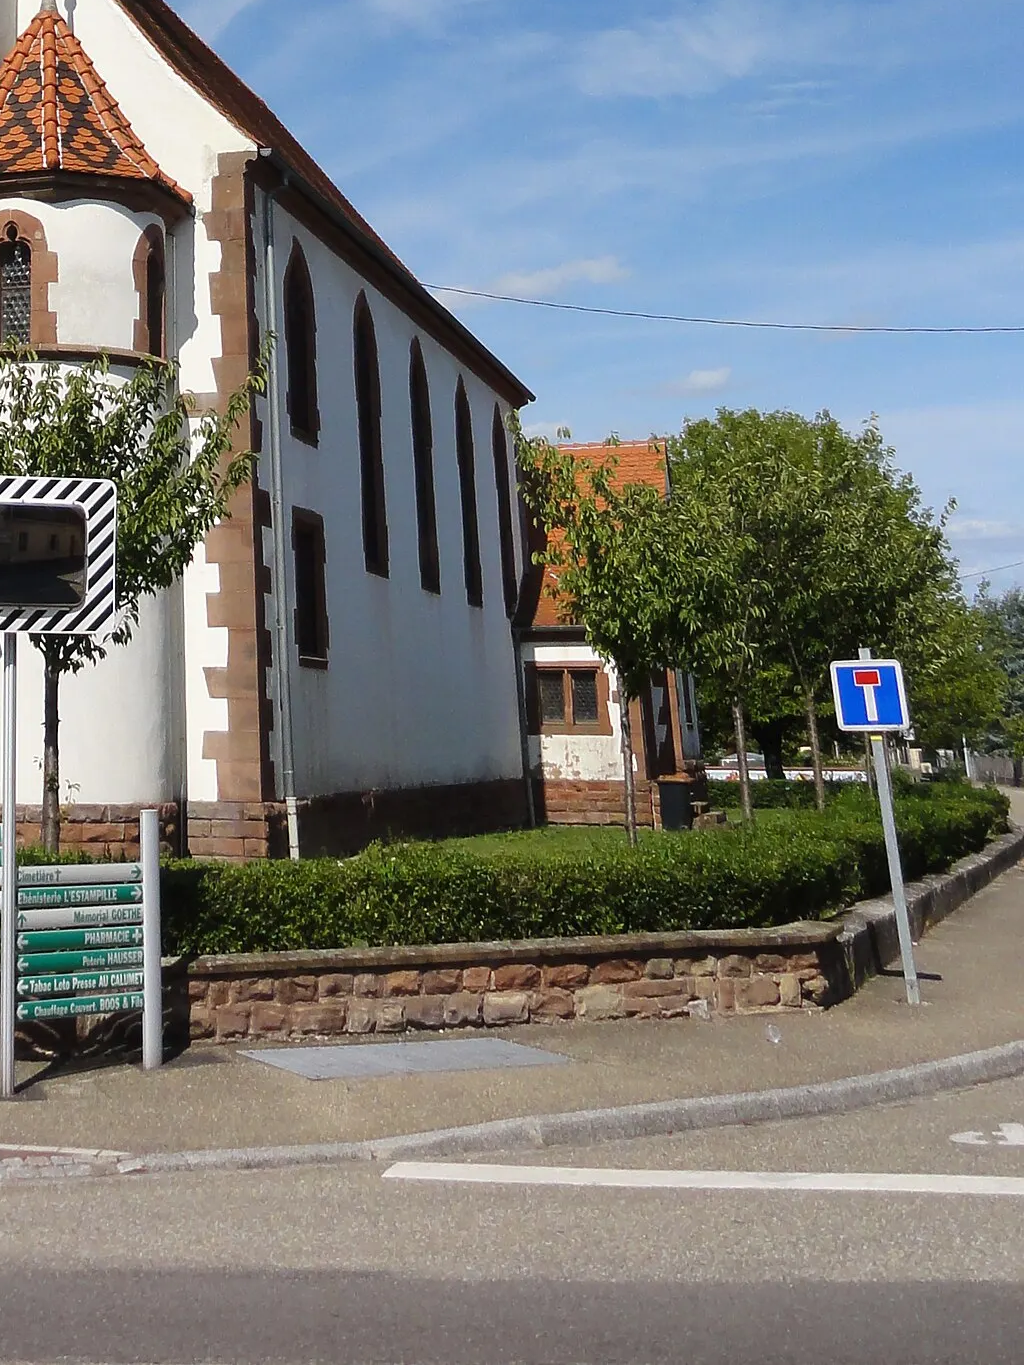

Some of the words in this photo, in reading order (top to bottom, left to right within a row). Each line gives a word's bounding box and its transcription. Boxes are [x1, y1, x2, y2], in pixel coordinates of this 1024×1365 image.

[64, 889, 117, 903] L'ESTAMPILLE
[73, 909, 108, 923] Mémorial
[111, 908, 141, 920] GOETHE
[84, 930, 130, 945] PHARMACIE
[107, 950, 143, 964] HAUSSER
[29, 980, 52, 993] Tabac
[54, 978, 70, 991] Loto
[72, 977, 97, 990] Presse
[98, 975, 109, 985] AU
[110, 972, 143, 986] CALUMET
[34, 1006, 68, 1017] Chauffage
[99, 998, 120, 1011] BOOS
[122, 996, 129, 1008] &
[131, 995, 143, 1008] Fils
